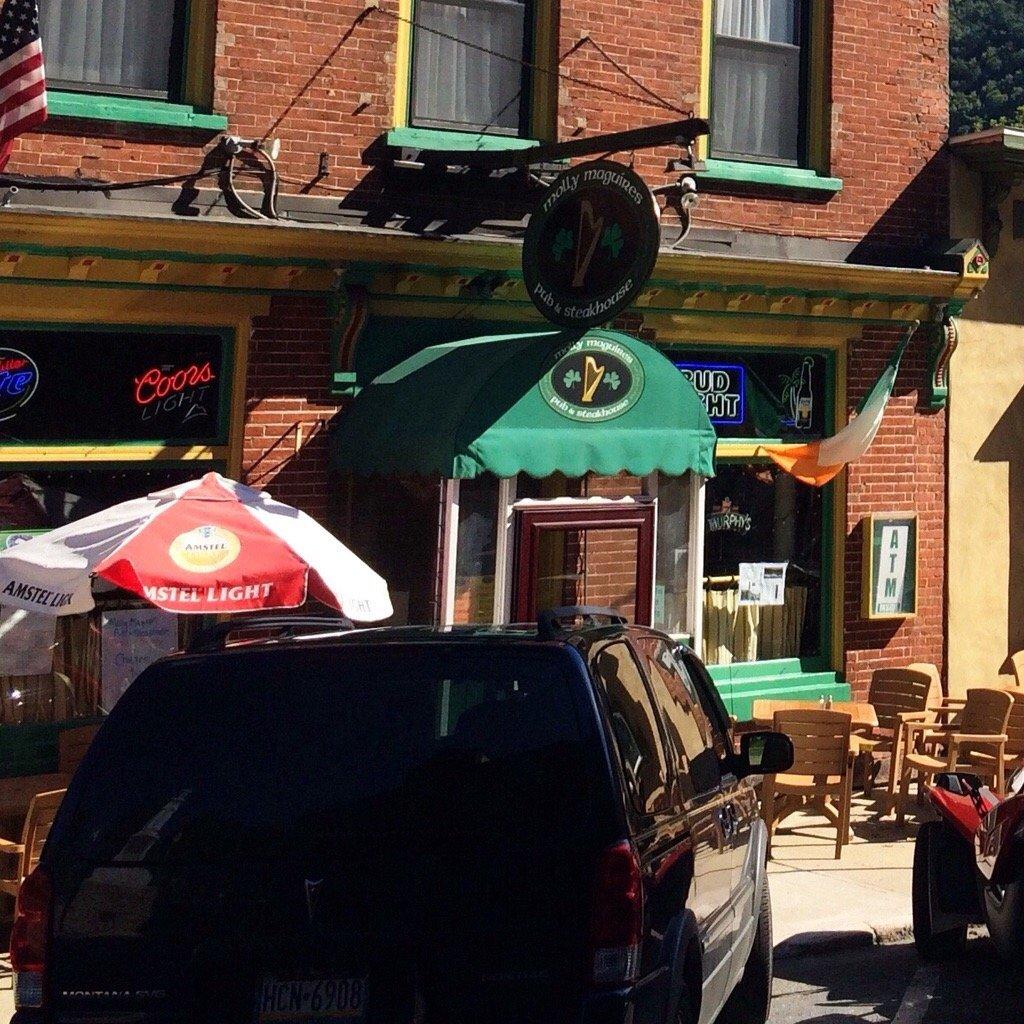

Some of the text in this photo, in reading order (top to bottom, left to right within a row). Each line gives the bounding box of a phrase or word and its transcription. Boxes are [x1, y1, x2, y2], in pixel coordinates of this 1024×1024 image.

[542, 168, 644, 213] molly maguires
[533, 278, 634, 319] pub & steakhouse
[135, 362, 216, 404] Coors
[141, 385, 211, 421] LIGHT
[550, 396, 629, 418] pub & steakhouse
[708, 513, 752, 532] MURPHY'S
[185, 543, 228, 551] AMSTEL
[884, 529, 899, 598] ATM
[2, 580, 54, 606] AMSTEL
[143, 582, 274, 603] MSTEL LIGHT
